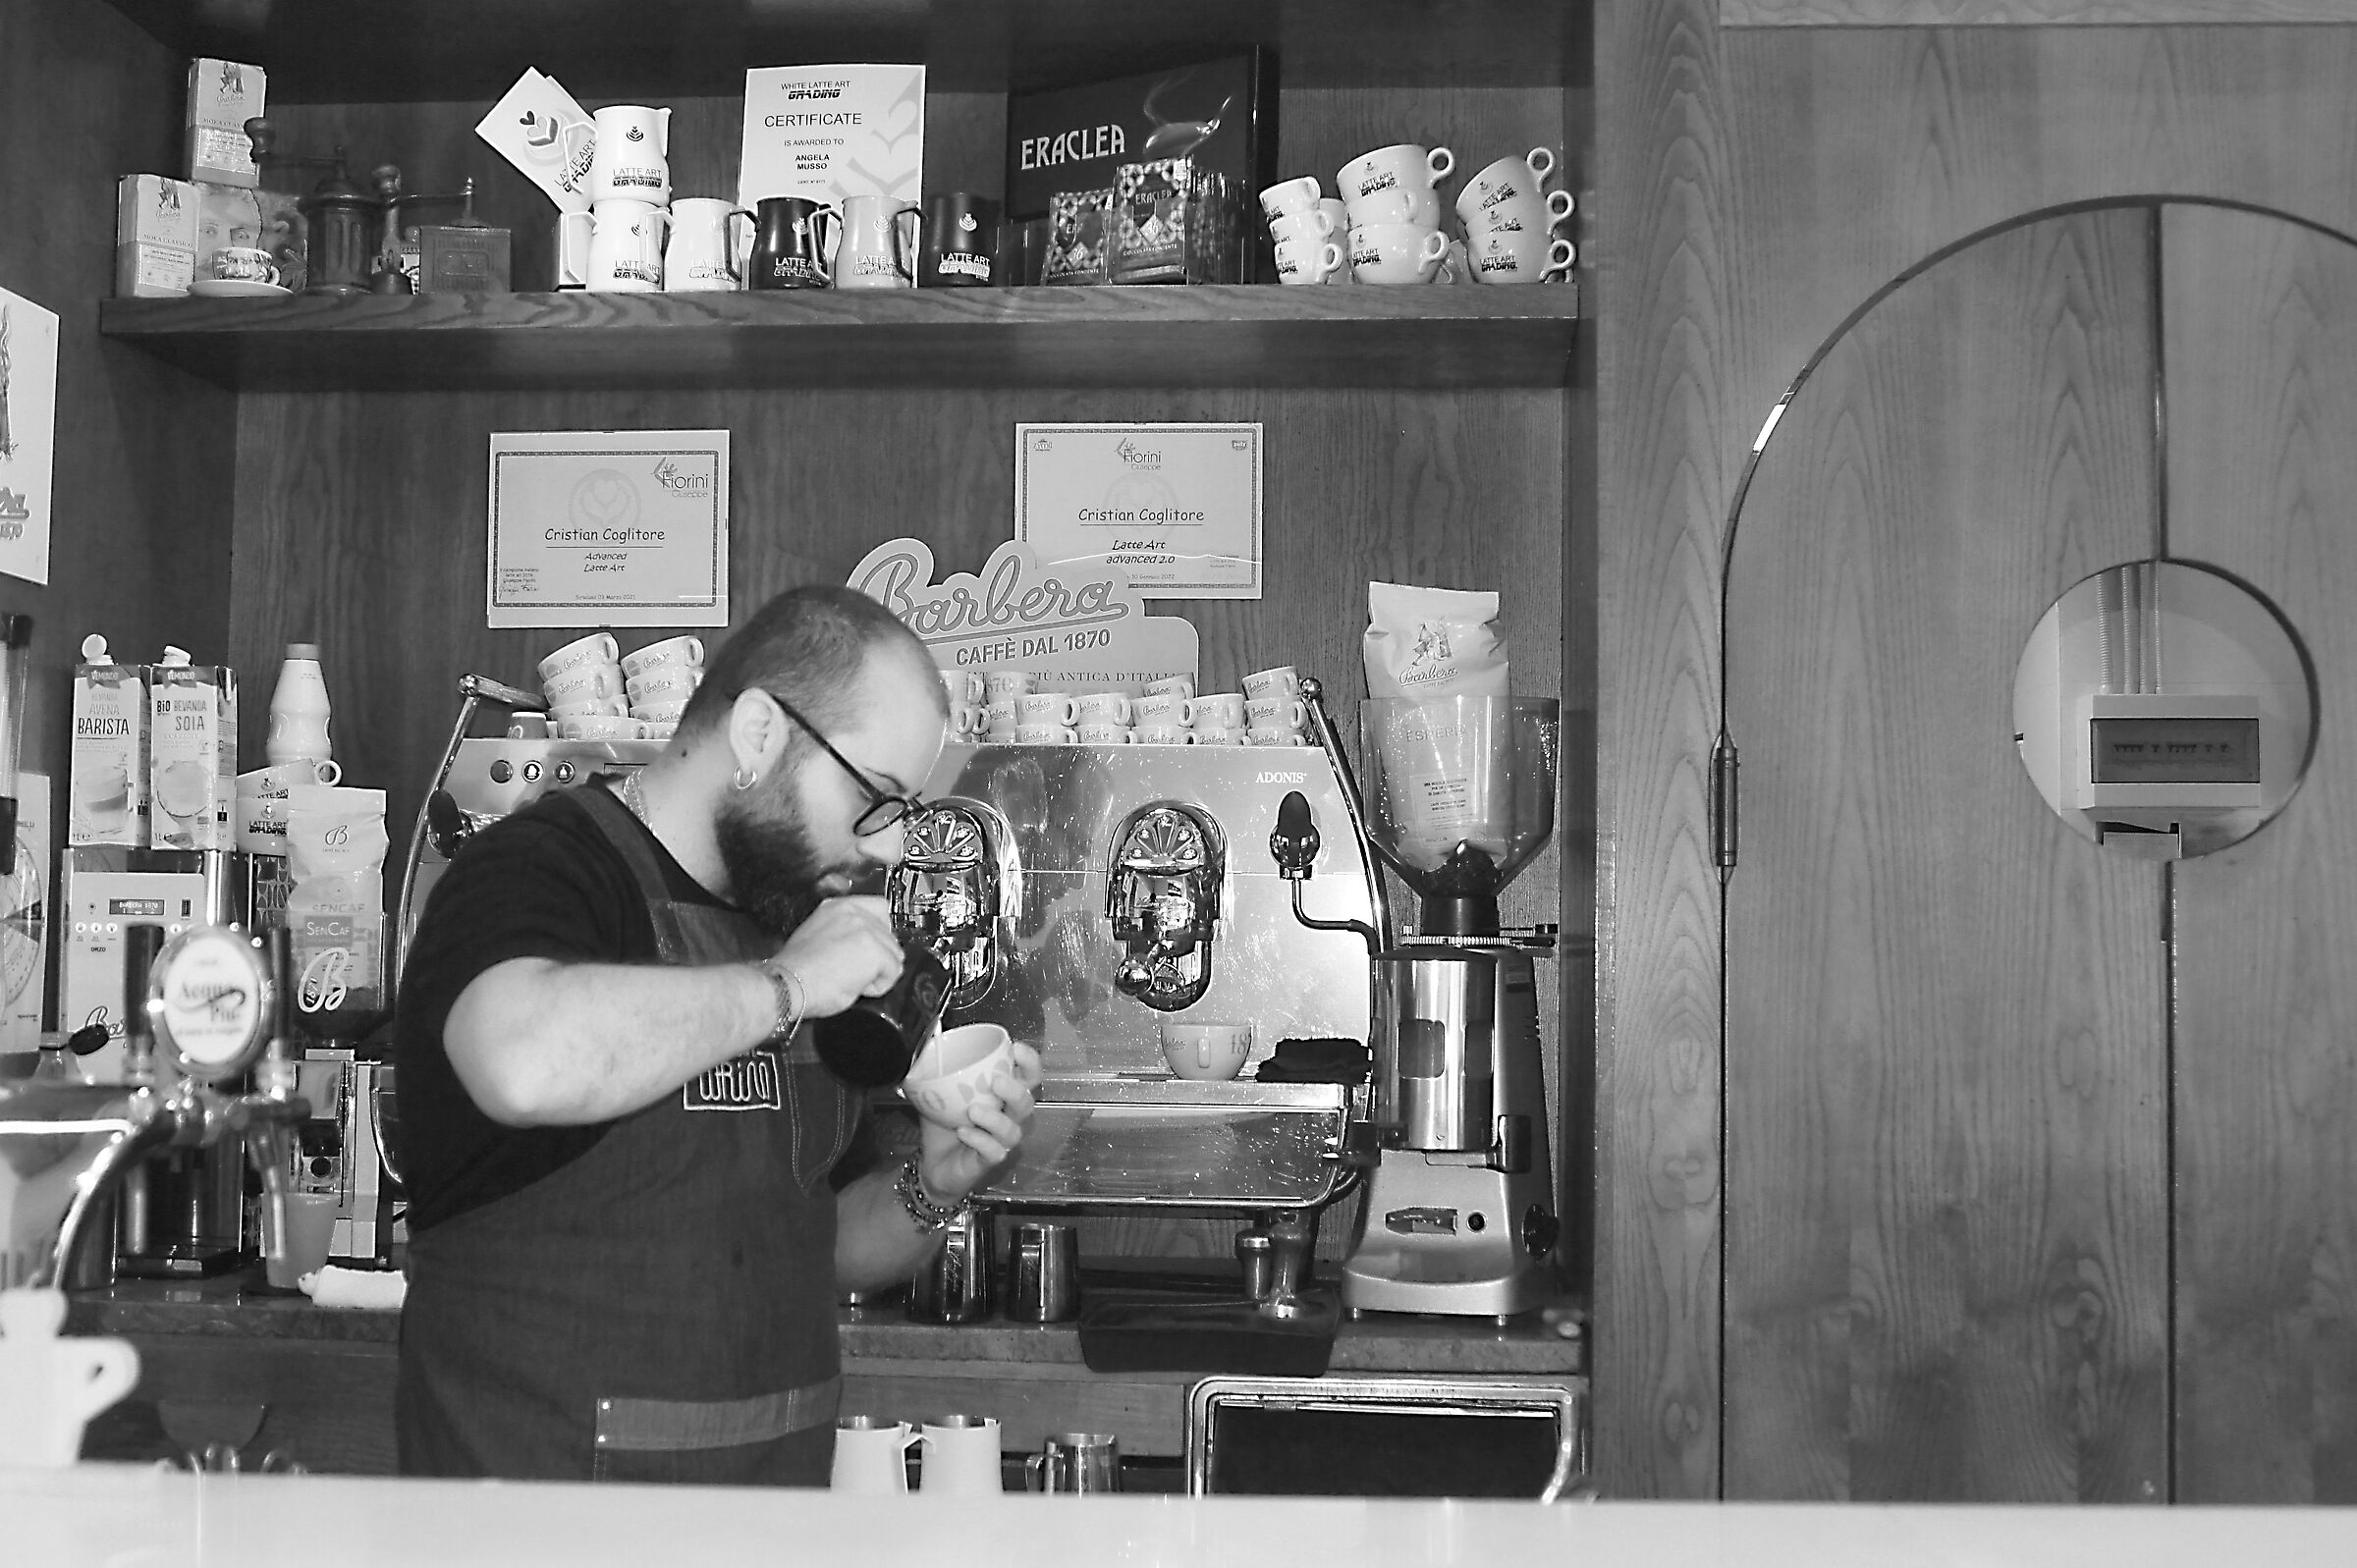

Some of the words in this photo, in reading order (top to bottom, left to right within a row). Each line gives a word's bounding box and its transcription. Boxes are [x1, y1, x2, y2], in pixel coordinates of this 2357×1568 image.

[808, 81, 833, 89] LATTE
[834, 80, 850, 88] ART
[788, 88, 842, 100] GRADING
[764, 113, 862, 128] CERTIFICATE
[1021, 124, 1125, 171] ERACLEA
[795, 153, 830, 162] ANGELA
[613, 167, 643, 177] LATTE
[644, 168, 662, 178] ART
[1358, 178, 1377, 189] LATTE
[1379, 171, 1394, 182] ART
[1497, 183, 1509, 195] ART
[1135, 189, 1172, 205] ERACLEA
[775, 256, 806, 266] LATTE
[941, 252, 973, 262] LATTE
[973, 254, 990, 266] ART
[1480, 255, 1499, 266] LATTE
[1124, 449, 1161, 463] Fiorini
[662, 471, 709, 489] Fiorini
[1077, 509, 1134, 521] Cristian
[1138, 509, 1205, 525] Coglitore
[544, 528, 598, 541] Cristian
[602, 528, 666, 544] Coglitore
[1112, 540, 1143, 551] Latte
[1144, 540, 1166, 551] Art
[584, 552, 628, 561] Advanced
[1106, 555, 1158, 565] advanced
[1158, 555, 1176, 565] 2.0
[583, 564, 608, 572] Latte
[610, 564, 626, 572] Art
[858, 552, 1130, 635] Barbera
[955, 637, 1016, 667] CAFFÈ
[1022, 635, 1059, 658] DAL
[1064, 628, 1111, 651] 1870
[1057, 672, 1111, 682] ANTICA
[1398, 663, 1459, 684] Barbera
[89, 704, 120, 715] AVENA
[173, 700, 207, 712] BEVANDA
[78, 718, 130, 735] BARISTA
[175, 716, 205, 730] SOIA
[1255, 771, 1305, 784] ADONIS
[275, 788, 289, 798] ART
[312, 903, 365, 913] SENCAF
